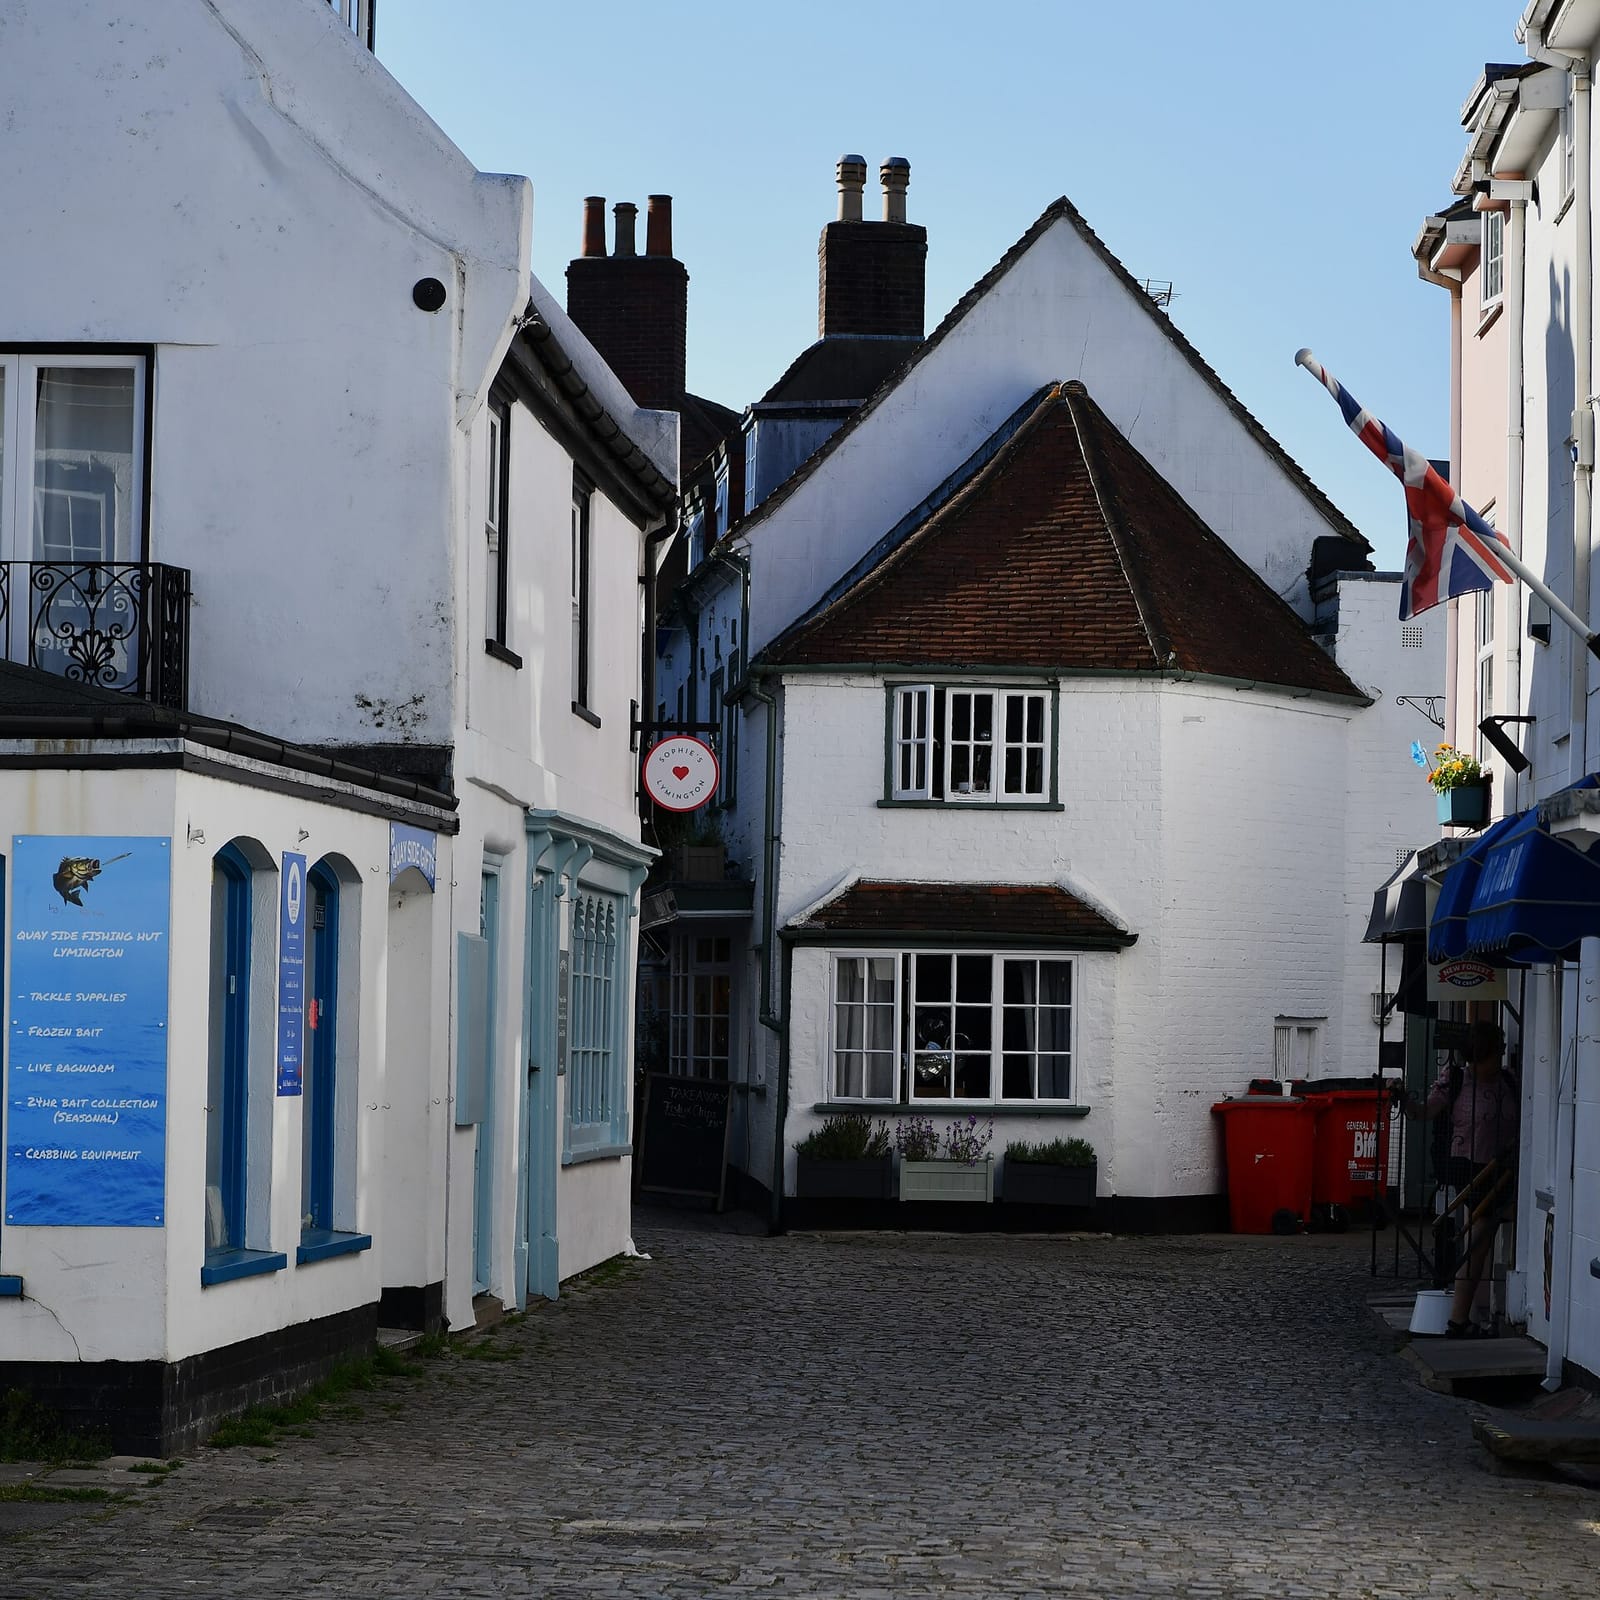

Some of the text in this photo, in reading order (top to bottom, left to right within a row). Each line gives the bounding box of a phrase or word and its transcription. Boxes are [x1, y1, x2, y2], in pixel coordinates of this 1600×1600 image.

[658, 747, 704, 763] SOPHIE'S
[656, 779, 705, 800] LYMINGTON
[16, 930, 163, 941] QUAY SIDE FISHING HUT
[53, 947, 124, 958] LYMINGTON
[30, 992, 128, 1002] TACKLE SUPPLIES
[75, 1027, 104, 1037] BAIT
[27, 1063, 115, 1073] LIVE RAGWORM
[27, 1097, 158, 1109] 24HR BAIT COLLECTION
[1346, 1121, 1369, 1131] GENERAL
[1353, 1131, 1377, 1158] Biff
[81, 1149, 142, 1161] EQUIPMENT
